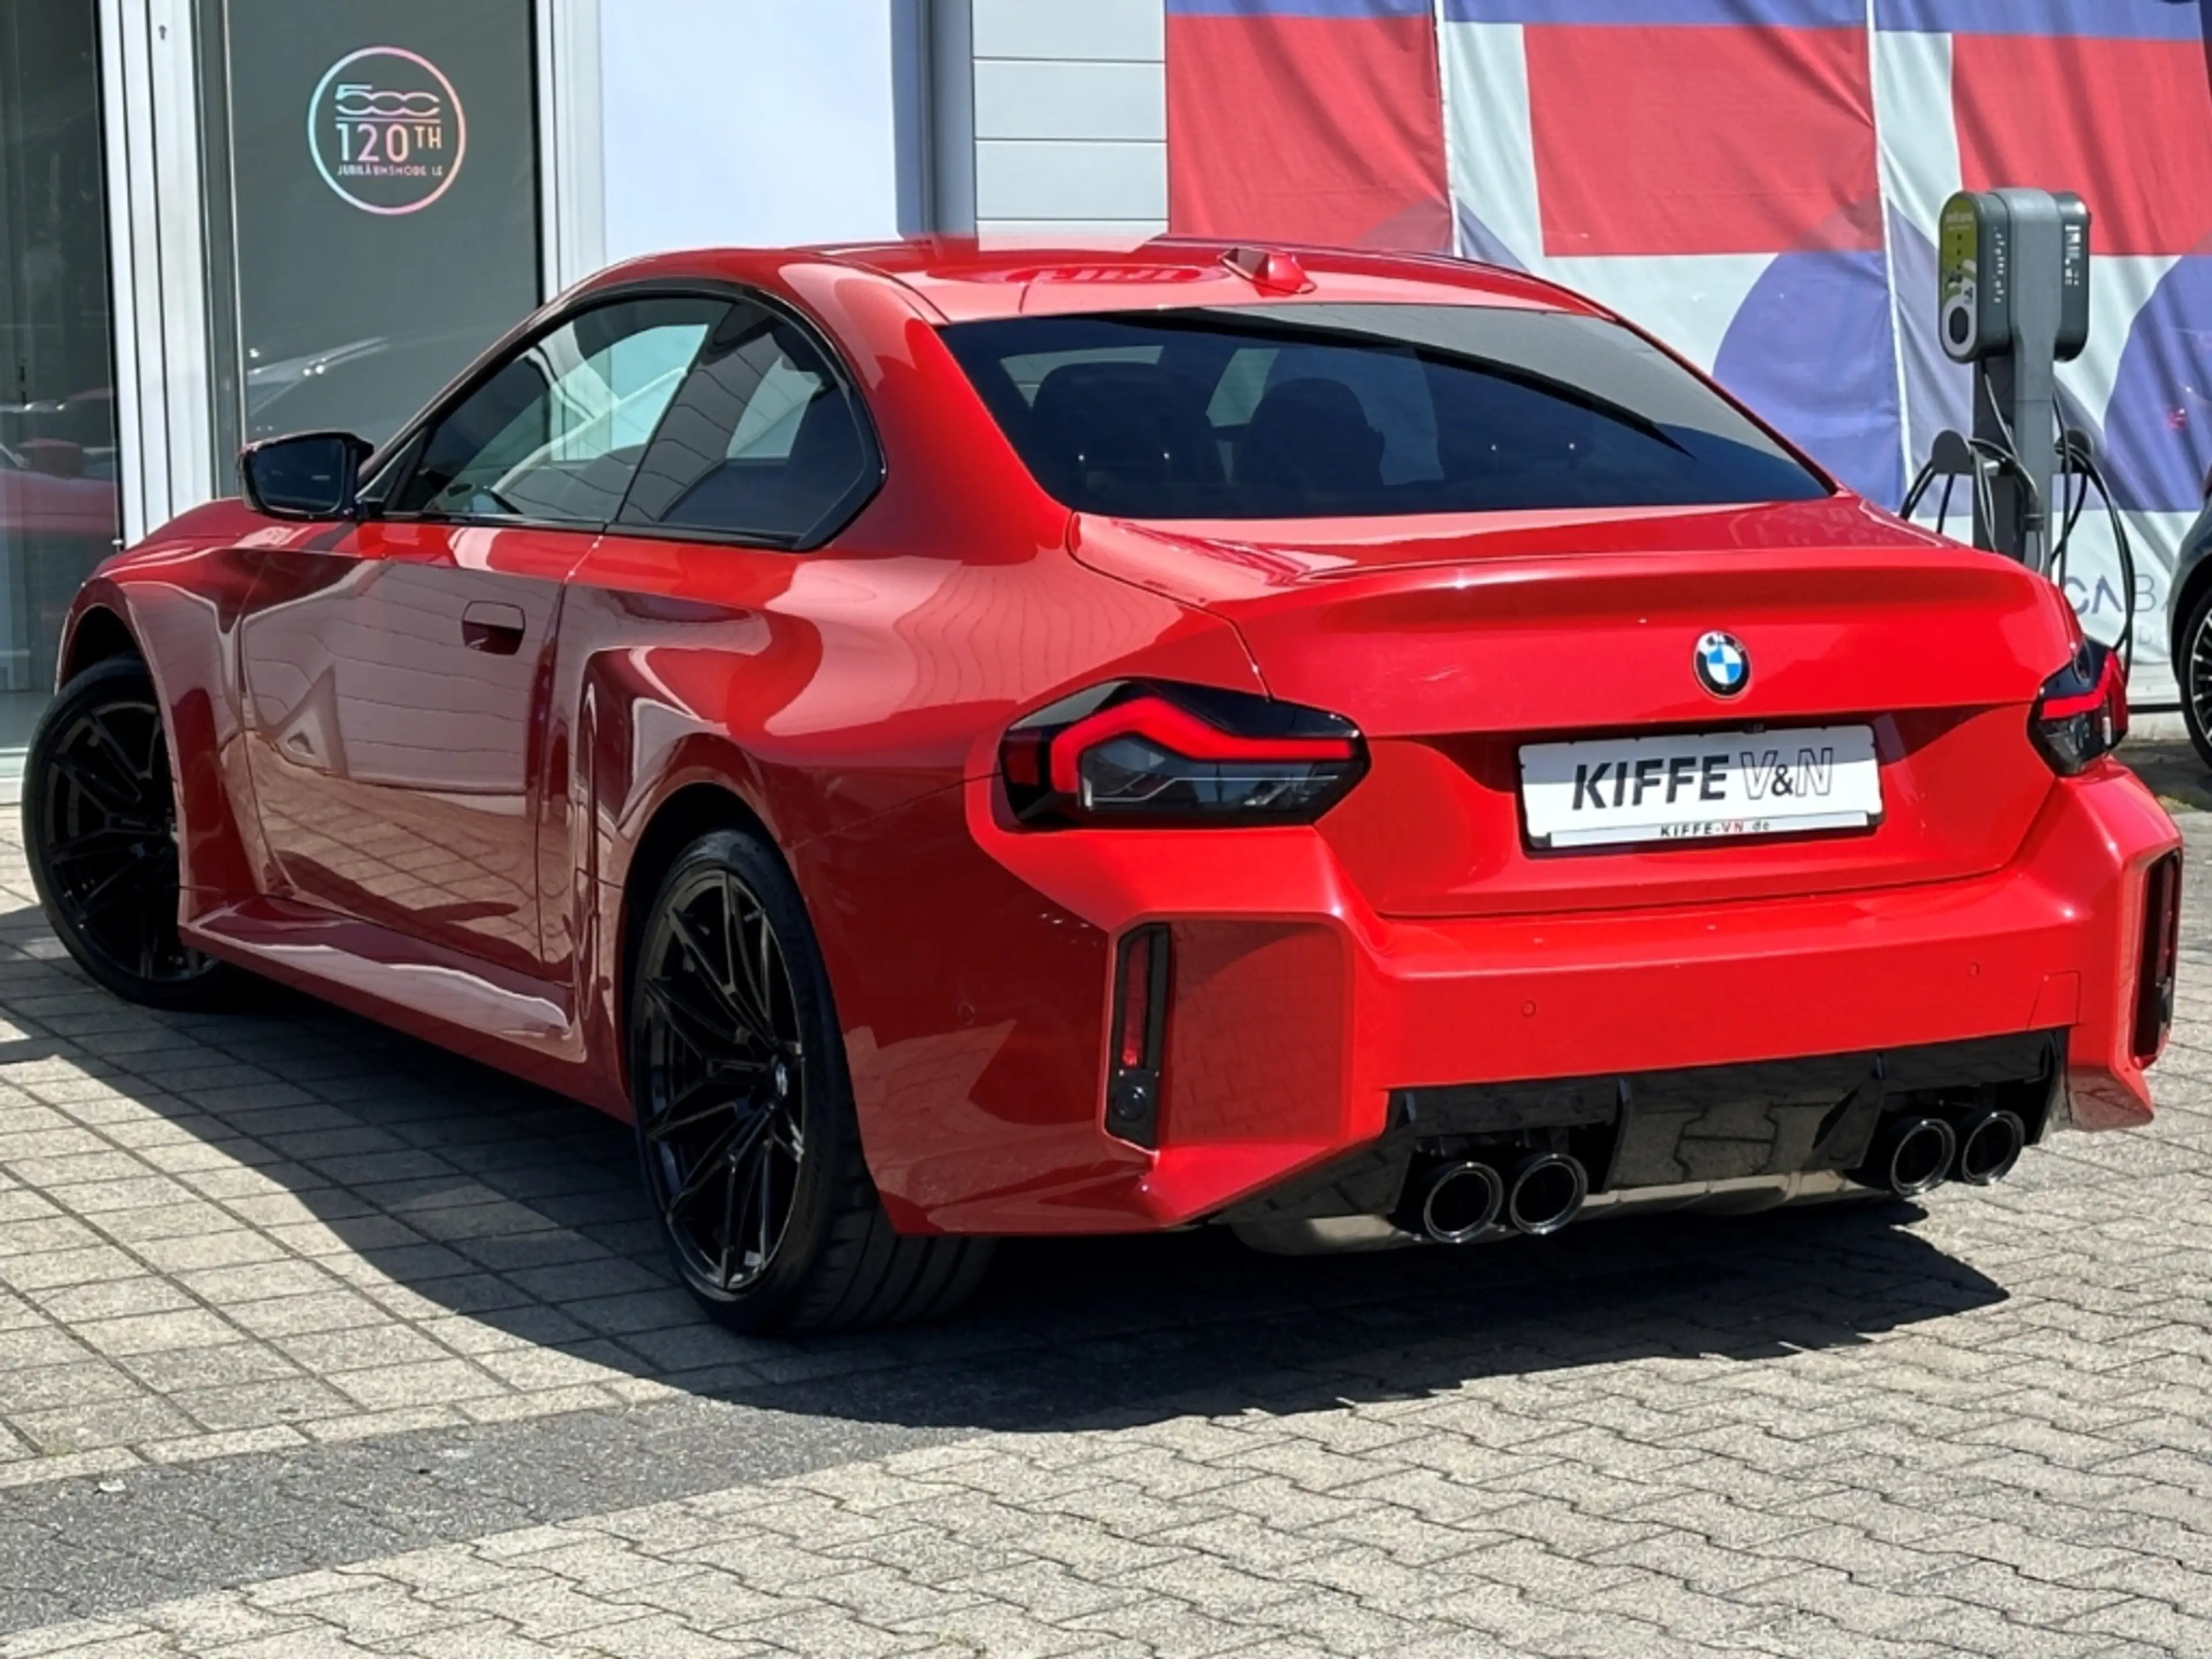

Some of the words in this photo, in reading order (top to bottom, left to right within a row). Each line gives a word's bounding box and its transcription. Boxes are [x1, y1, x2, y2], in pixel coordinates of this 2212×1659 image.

[335, 84, 440, 116] 500
[1572, 754, 1729, 810] KIFFE
[1740, 747, 1834, 800] V&N
